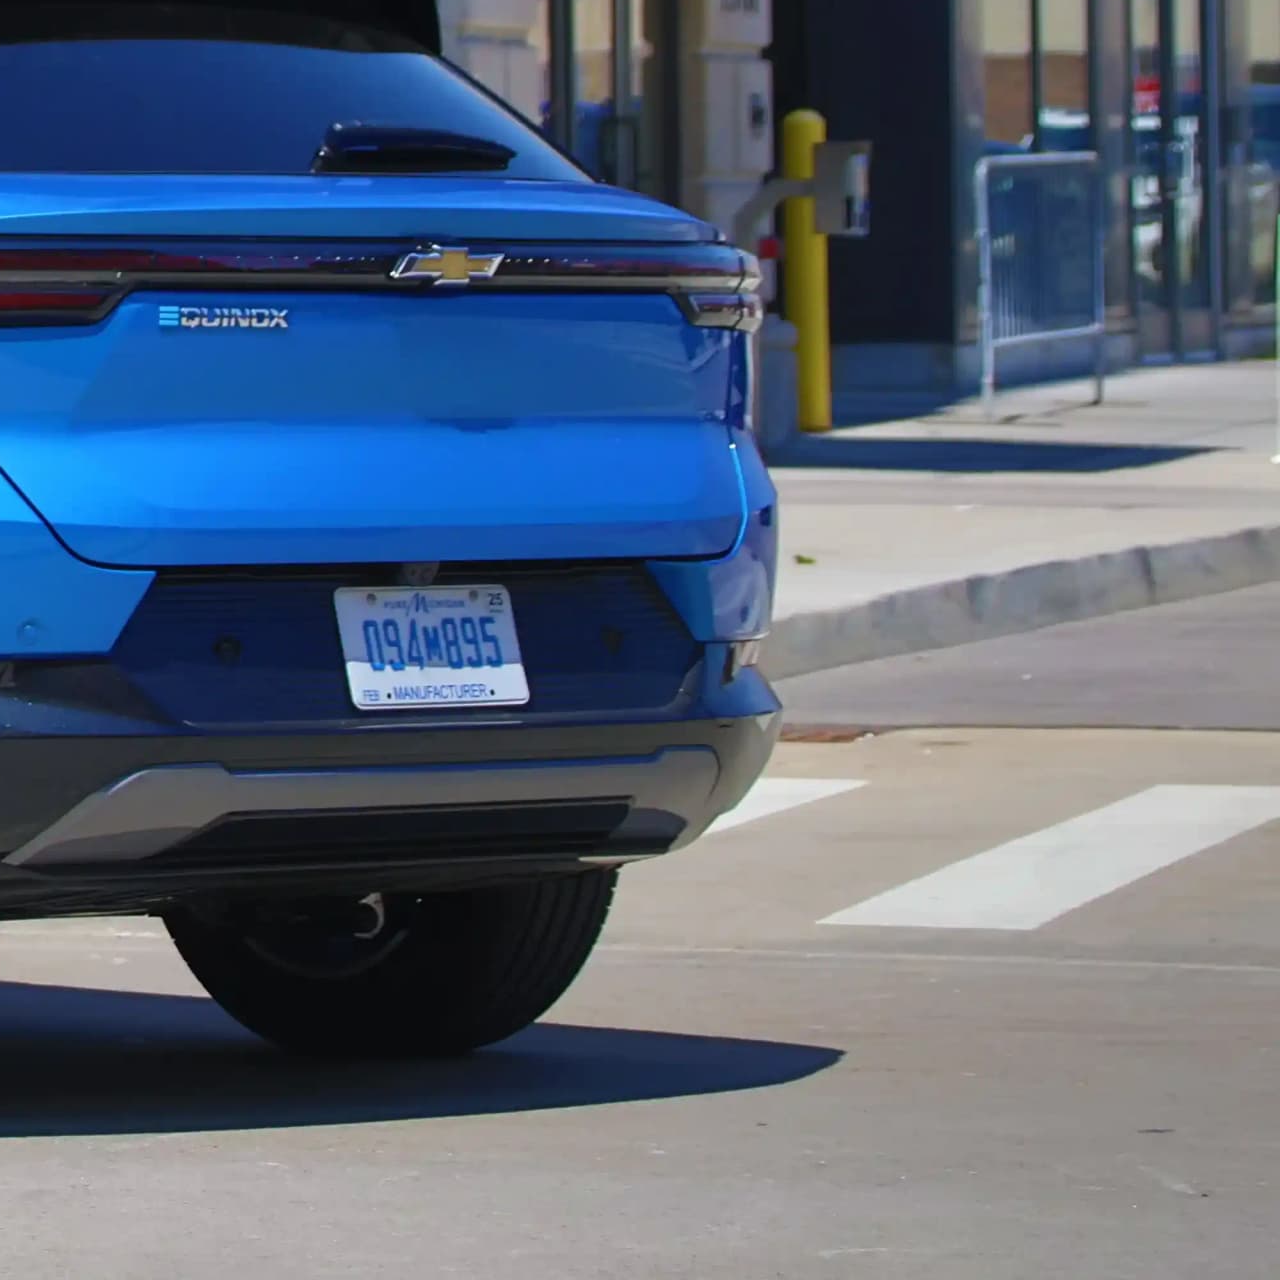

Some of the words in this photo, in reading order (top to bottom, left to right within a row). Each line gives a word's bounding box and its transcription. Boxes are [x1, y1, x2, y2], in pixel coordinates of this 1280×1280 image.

[159, 306, 288, 328] EQUINOX
[362, 616, 505, 672] 094M895
[393, 683, 487, 701] MANUFACTURER
